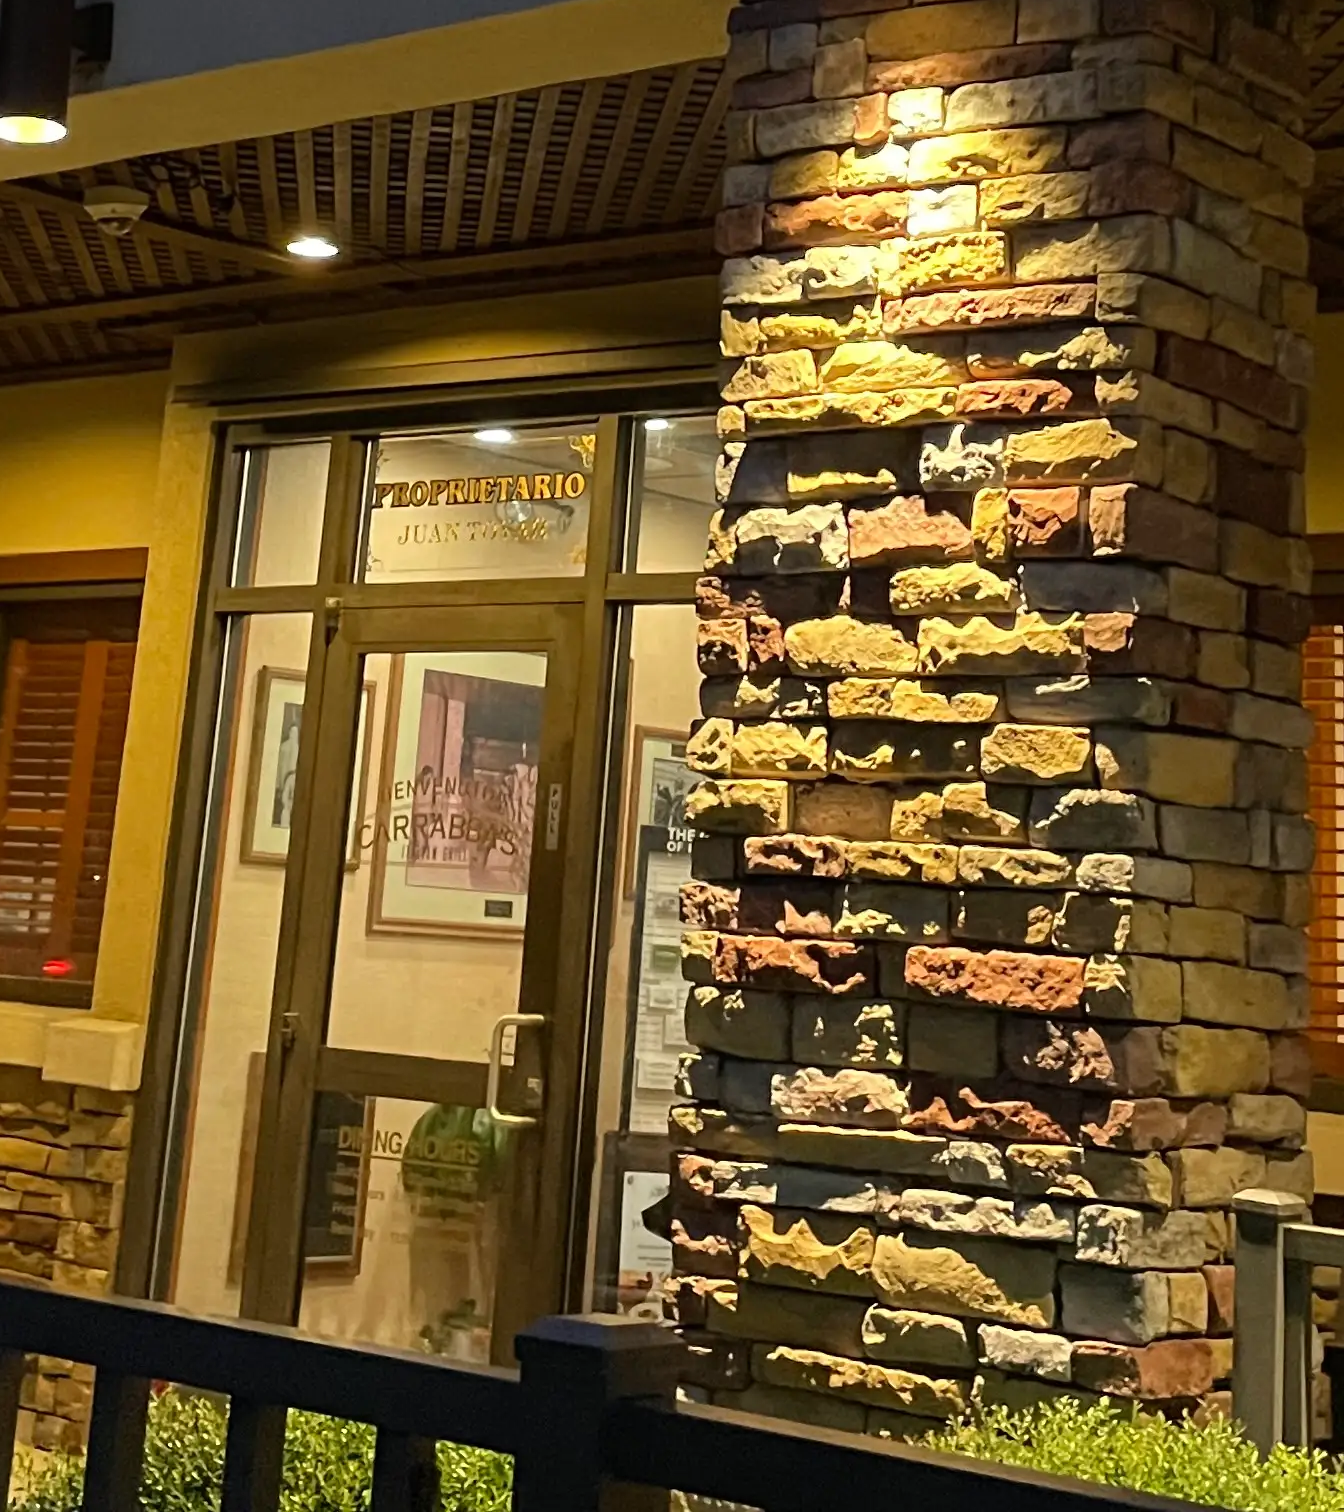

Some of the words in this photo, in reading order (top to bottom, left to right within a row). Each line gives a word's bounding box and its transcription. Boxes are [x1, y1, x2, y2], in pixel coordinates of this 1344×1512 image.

[372, 471, 586, 508] PROPRIETARIO
[397, 521, 461, 545] JUAN
[549, 788, 559, 834] PULL
[667, 826, 696, 842] THE
